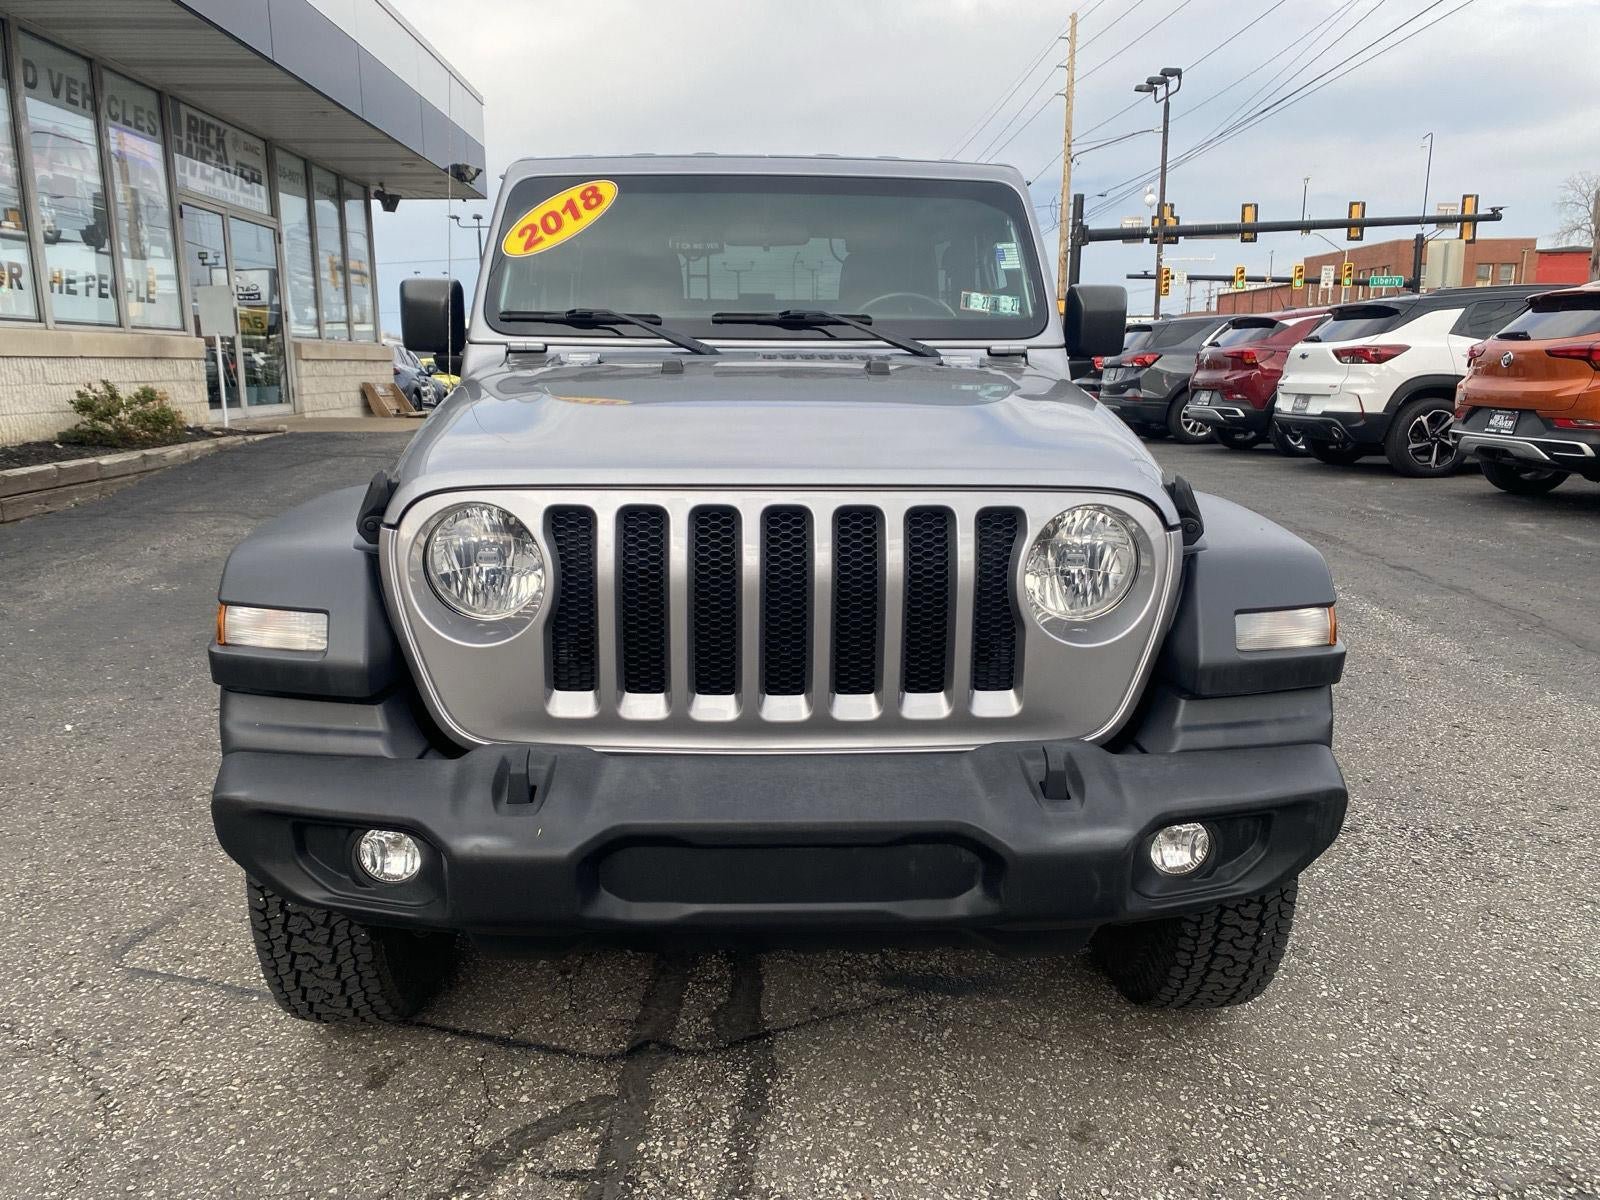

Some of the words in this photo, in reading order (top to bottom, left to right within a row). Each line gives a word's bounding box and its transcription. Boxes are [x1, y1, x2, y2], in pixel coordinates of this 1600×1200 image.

[186, 112, 227, 158] RICK
[174, 137, 263, 198] WEAVER
[518, 186, 604, 252] 2018
[1373, 277, 1400, 286] Liberty
[1489, 419, 1514, 428] WEAVER
